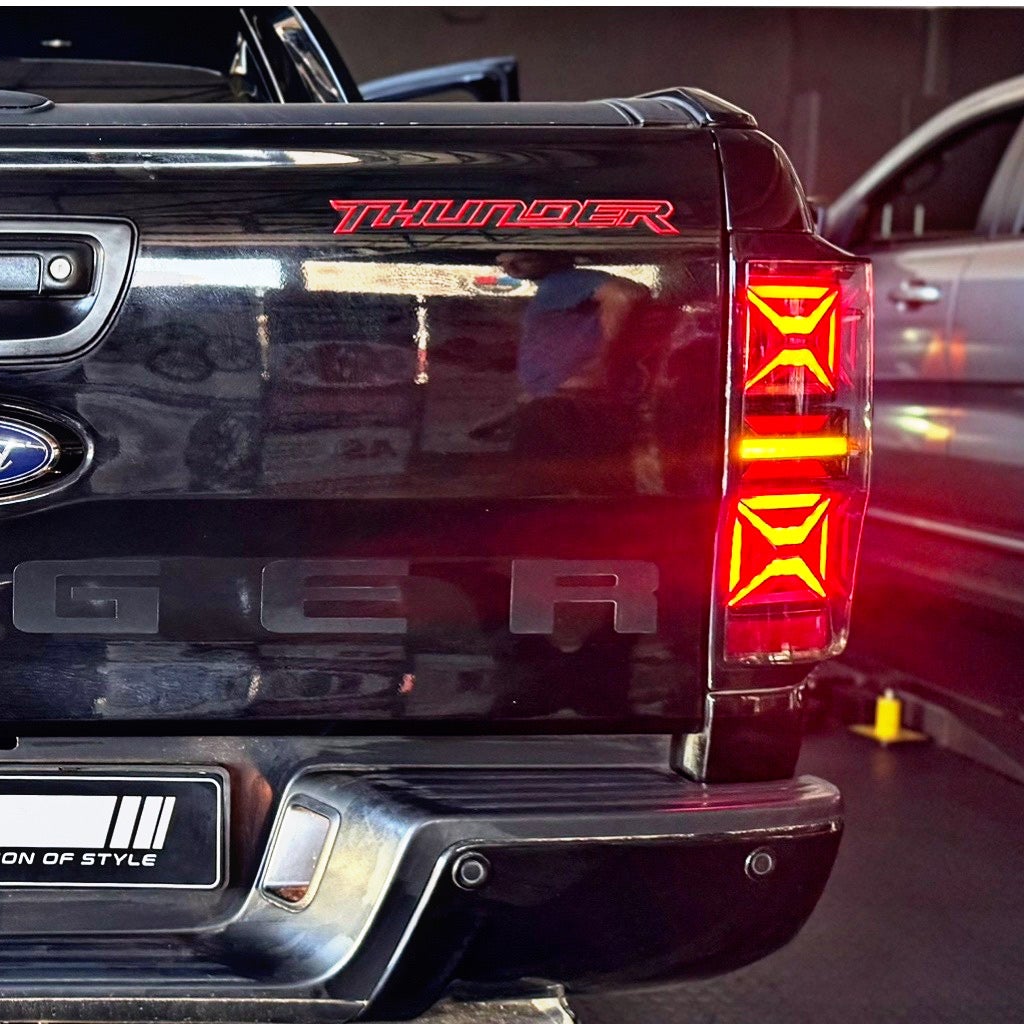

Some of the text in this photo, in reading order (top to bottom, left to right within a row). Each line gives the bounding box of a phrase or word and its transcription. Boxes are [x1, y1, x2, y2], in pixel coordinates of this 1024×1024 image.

[329, 198, 681, 236] THUNDER
[42, 852, 75, 865] OF
[80, 852, 158, 867] STYLE
